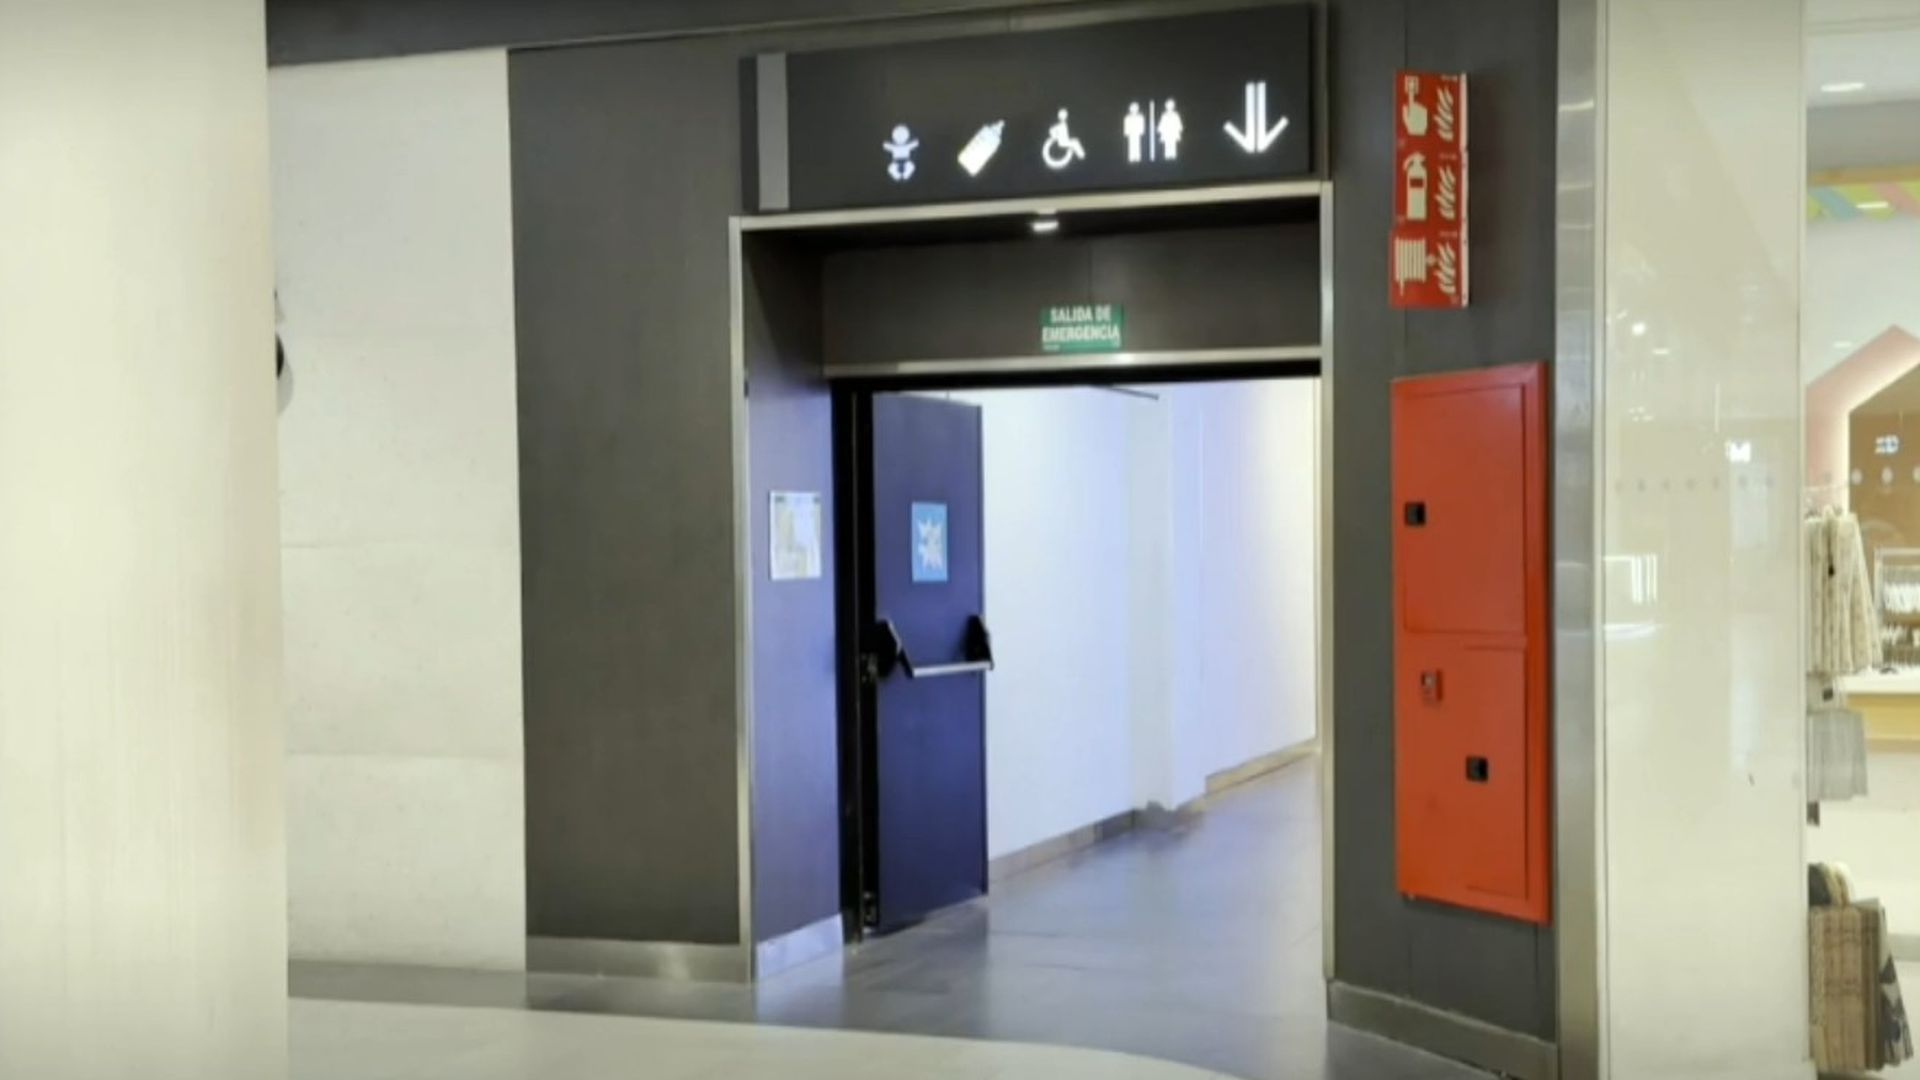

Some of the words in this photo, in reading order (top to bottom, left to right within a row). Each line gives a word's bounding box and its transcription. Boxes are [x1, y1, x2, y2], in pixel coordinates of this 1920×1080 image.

[1050, 305, 1093, 323] SALIDA
[1095, 304, 1112, 321] DE
[1042, 324, 1121, 343] EMERGENCIA
